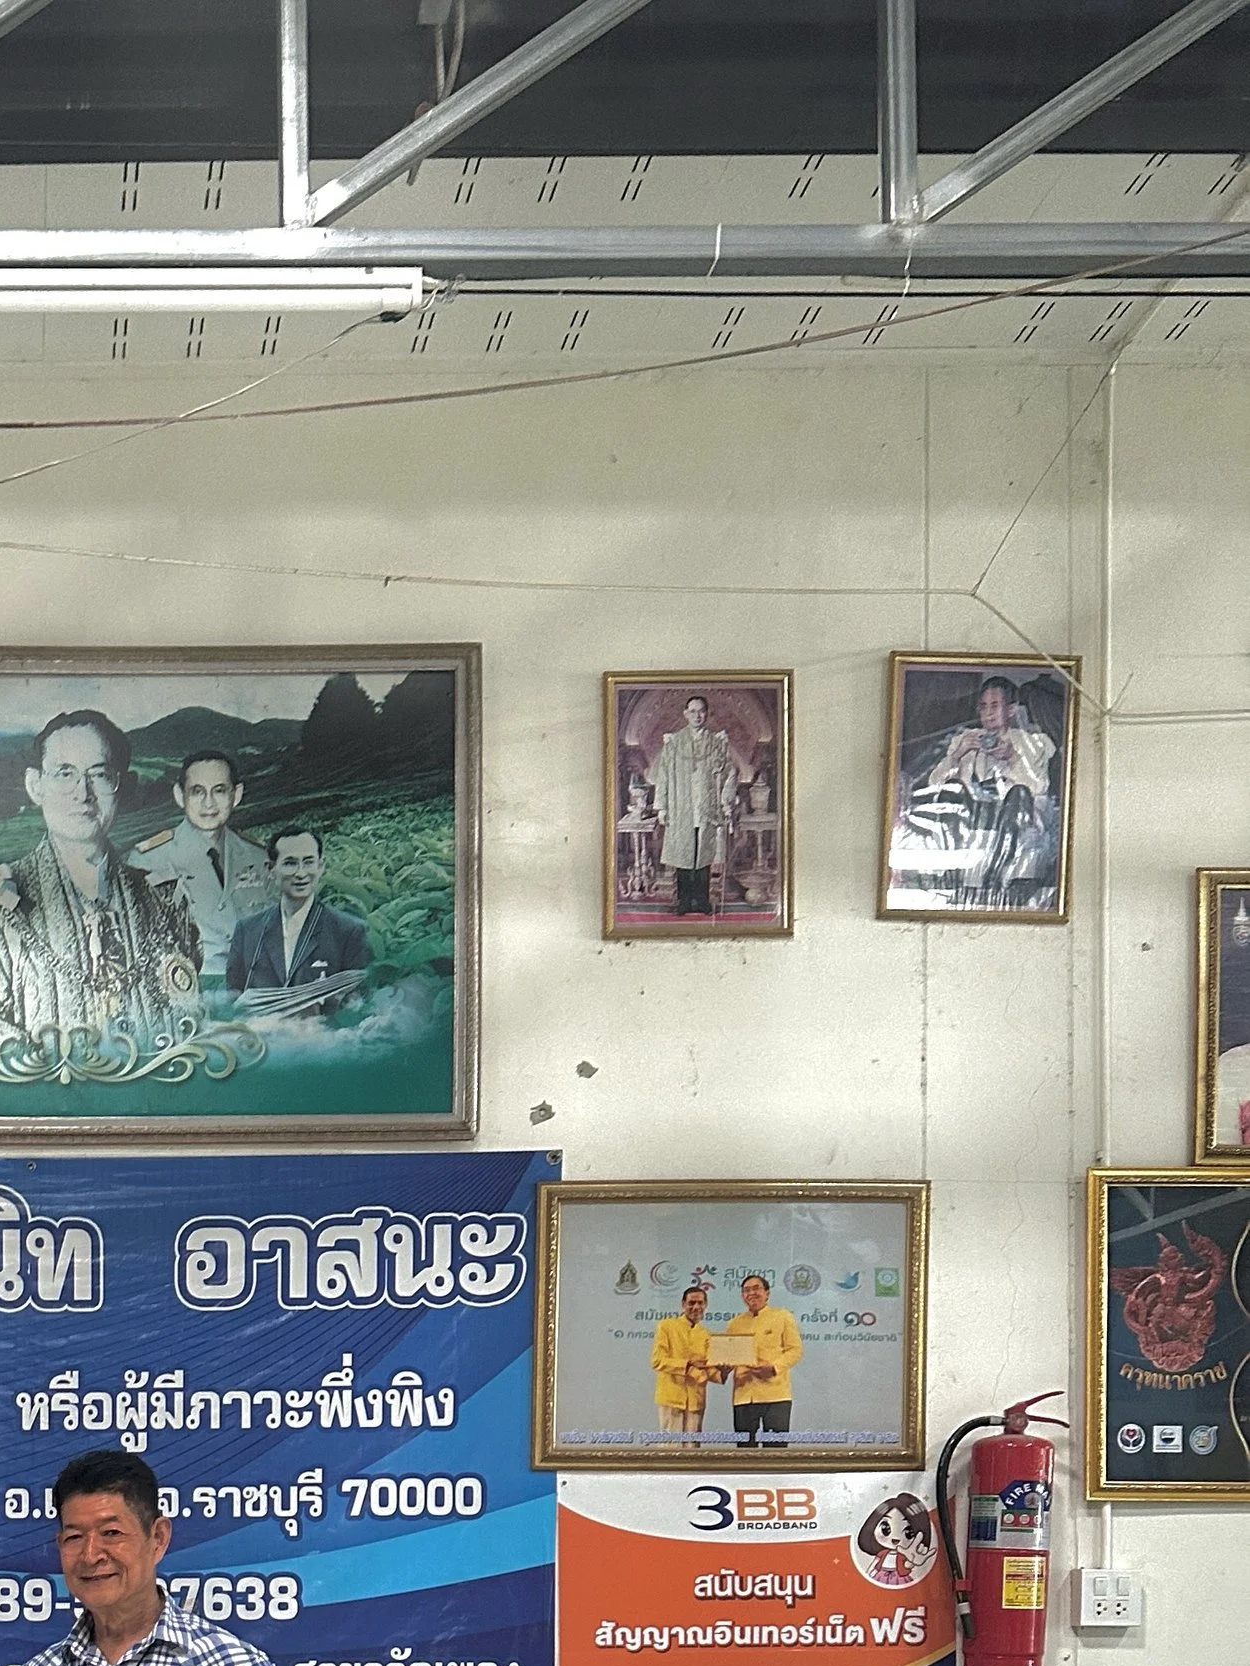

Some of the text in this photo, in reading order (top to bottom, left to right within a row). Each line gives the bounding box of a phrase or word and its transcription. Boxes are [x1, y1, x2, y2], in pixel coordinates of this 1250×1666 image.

[178, 1208, 526, 1309] อาสนะ
[844, 1311, 876, 1327] ๑๐
[16, 1355, 455, 1453] หรือผู้มีภาวะพึ่งพิง
[158, 1468, 323, 1537] จ.ราชบุรี
[342, 1478, 484, 1518] 70000
[687, 1485, 817, 1531] 3BB
[1006, 1483, 1032, 1506] FIRE
[737, 1521, 817, 1530] BROADBAND
[694, 1568, 815, 1608] สนับสนุน
[595, 1606, 928, 1652] สัญญาณอินเทอร์เน็ต ฟรี
